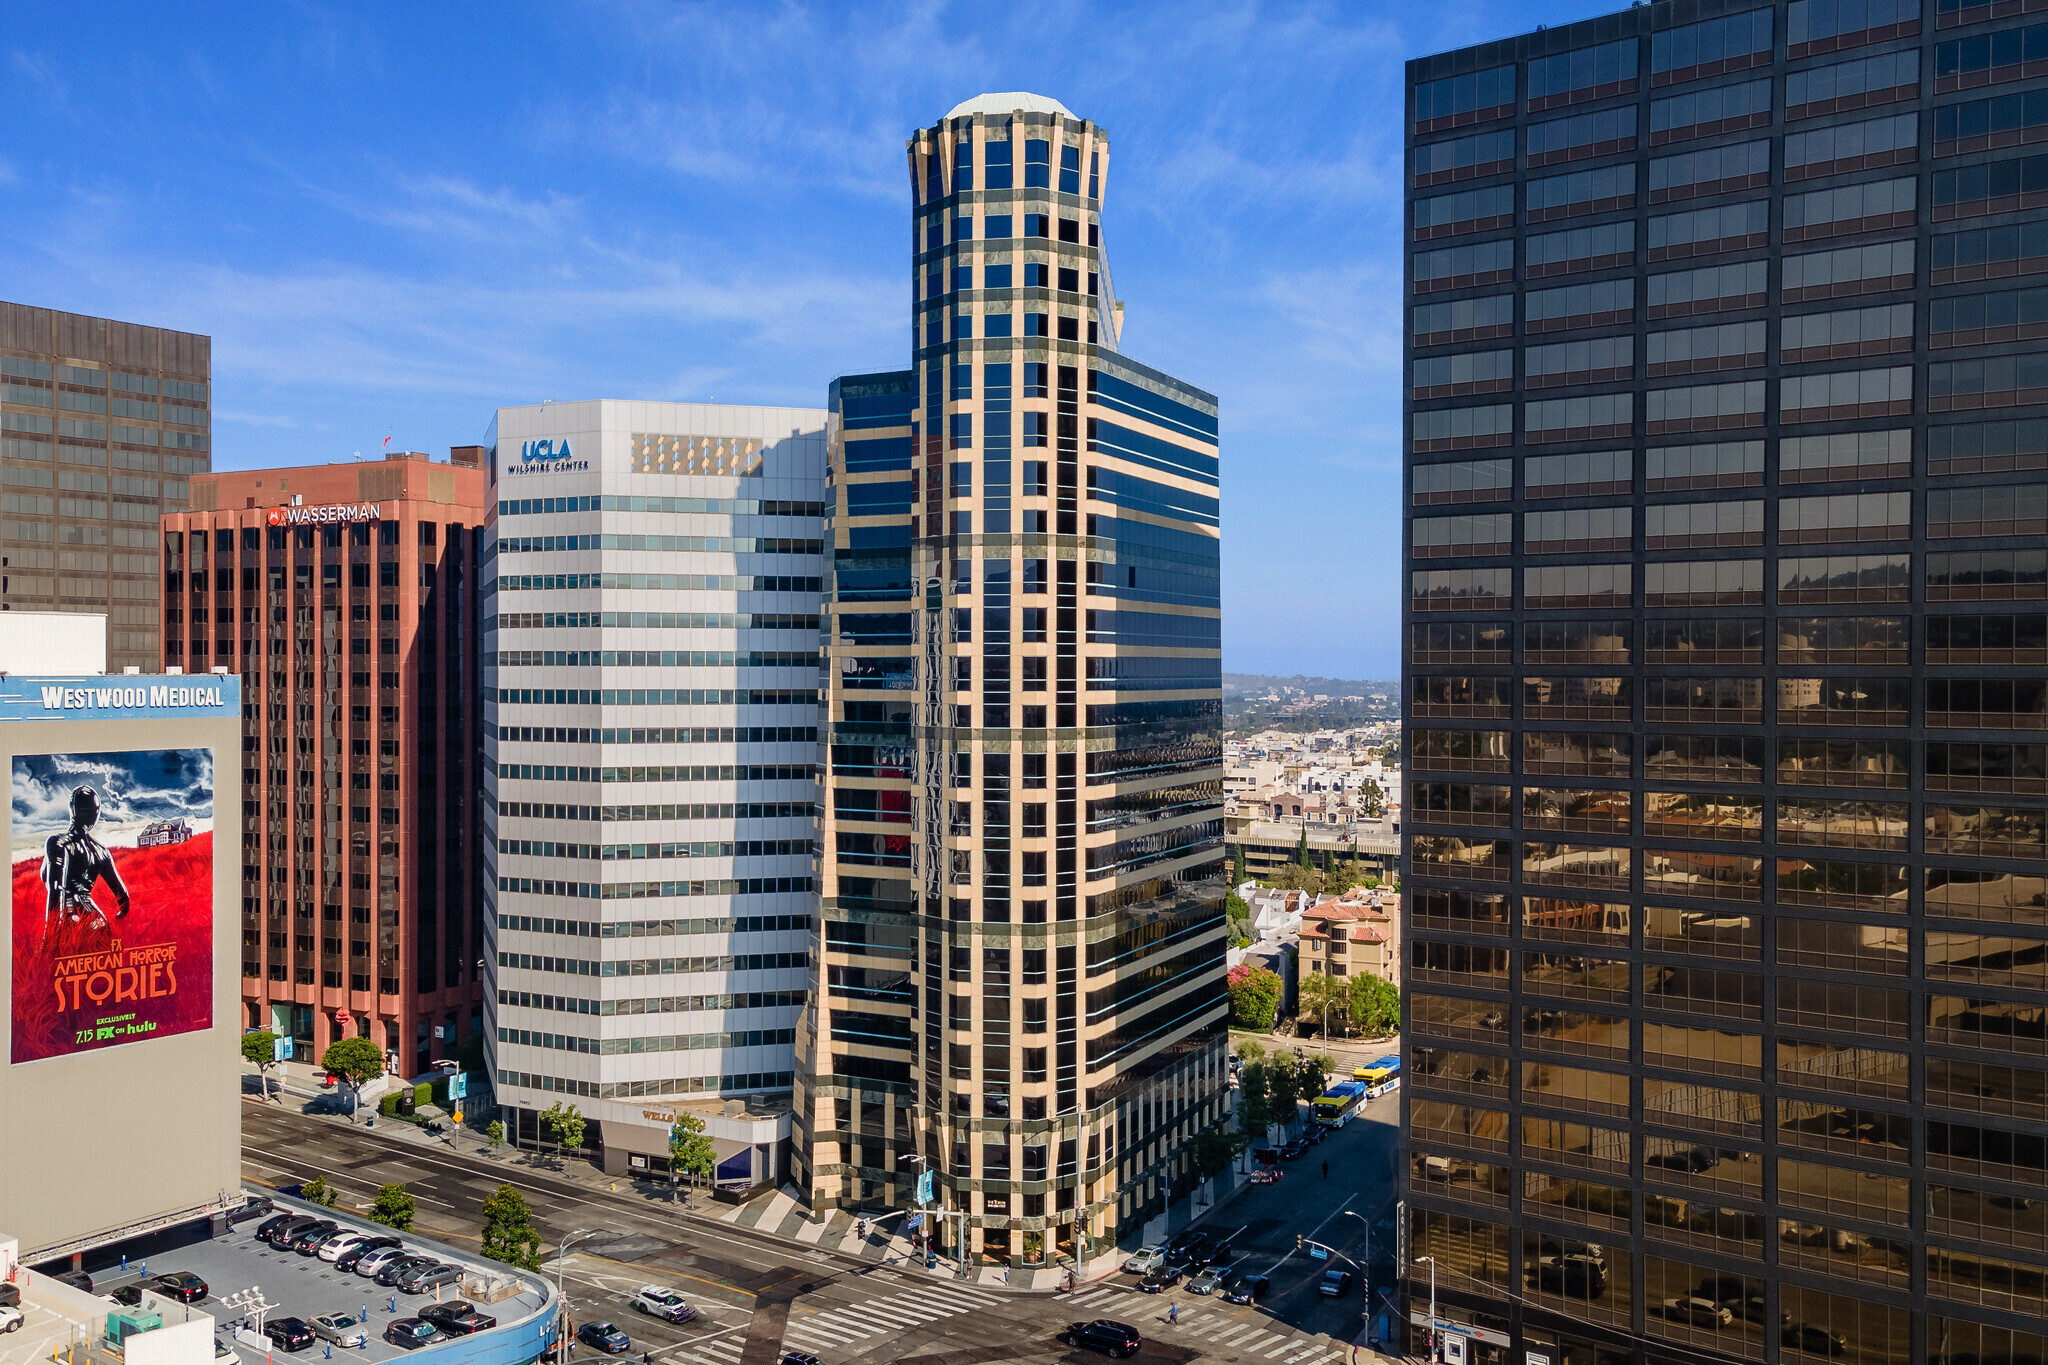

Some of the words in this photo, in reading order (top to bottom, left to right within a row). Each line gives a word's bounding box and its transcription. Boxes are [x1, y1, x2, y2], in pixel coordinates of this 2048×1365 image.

[524, 438, 572, 463] UCLA
[508, 463, 550, 475] WILSHIRE
[554, 461, 589, 473] CENTER
[287, 504, 381, 523] WASSERMAN
[41, 686, 147, 710] WESTWOOD
[150, 685, 224, 708] MEDICAL
[111, 938, 122, 952] FX
[54, 953, 123, 976] AMERICAN
[129, 946, 177, 966] HORROR
[54, 961, 177, 1013] STORIES
[96, 1013, 136, 1026] EXCLUSIVELY
[76, 1029, 94, 1045] 7.15
[96, 1026, 115, 1041] FX
[115, 1027, 125, 1035] ON
[127, 1020, 157, 1035] hulu
[642, 1110, 674, 1123] WELLS
